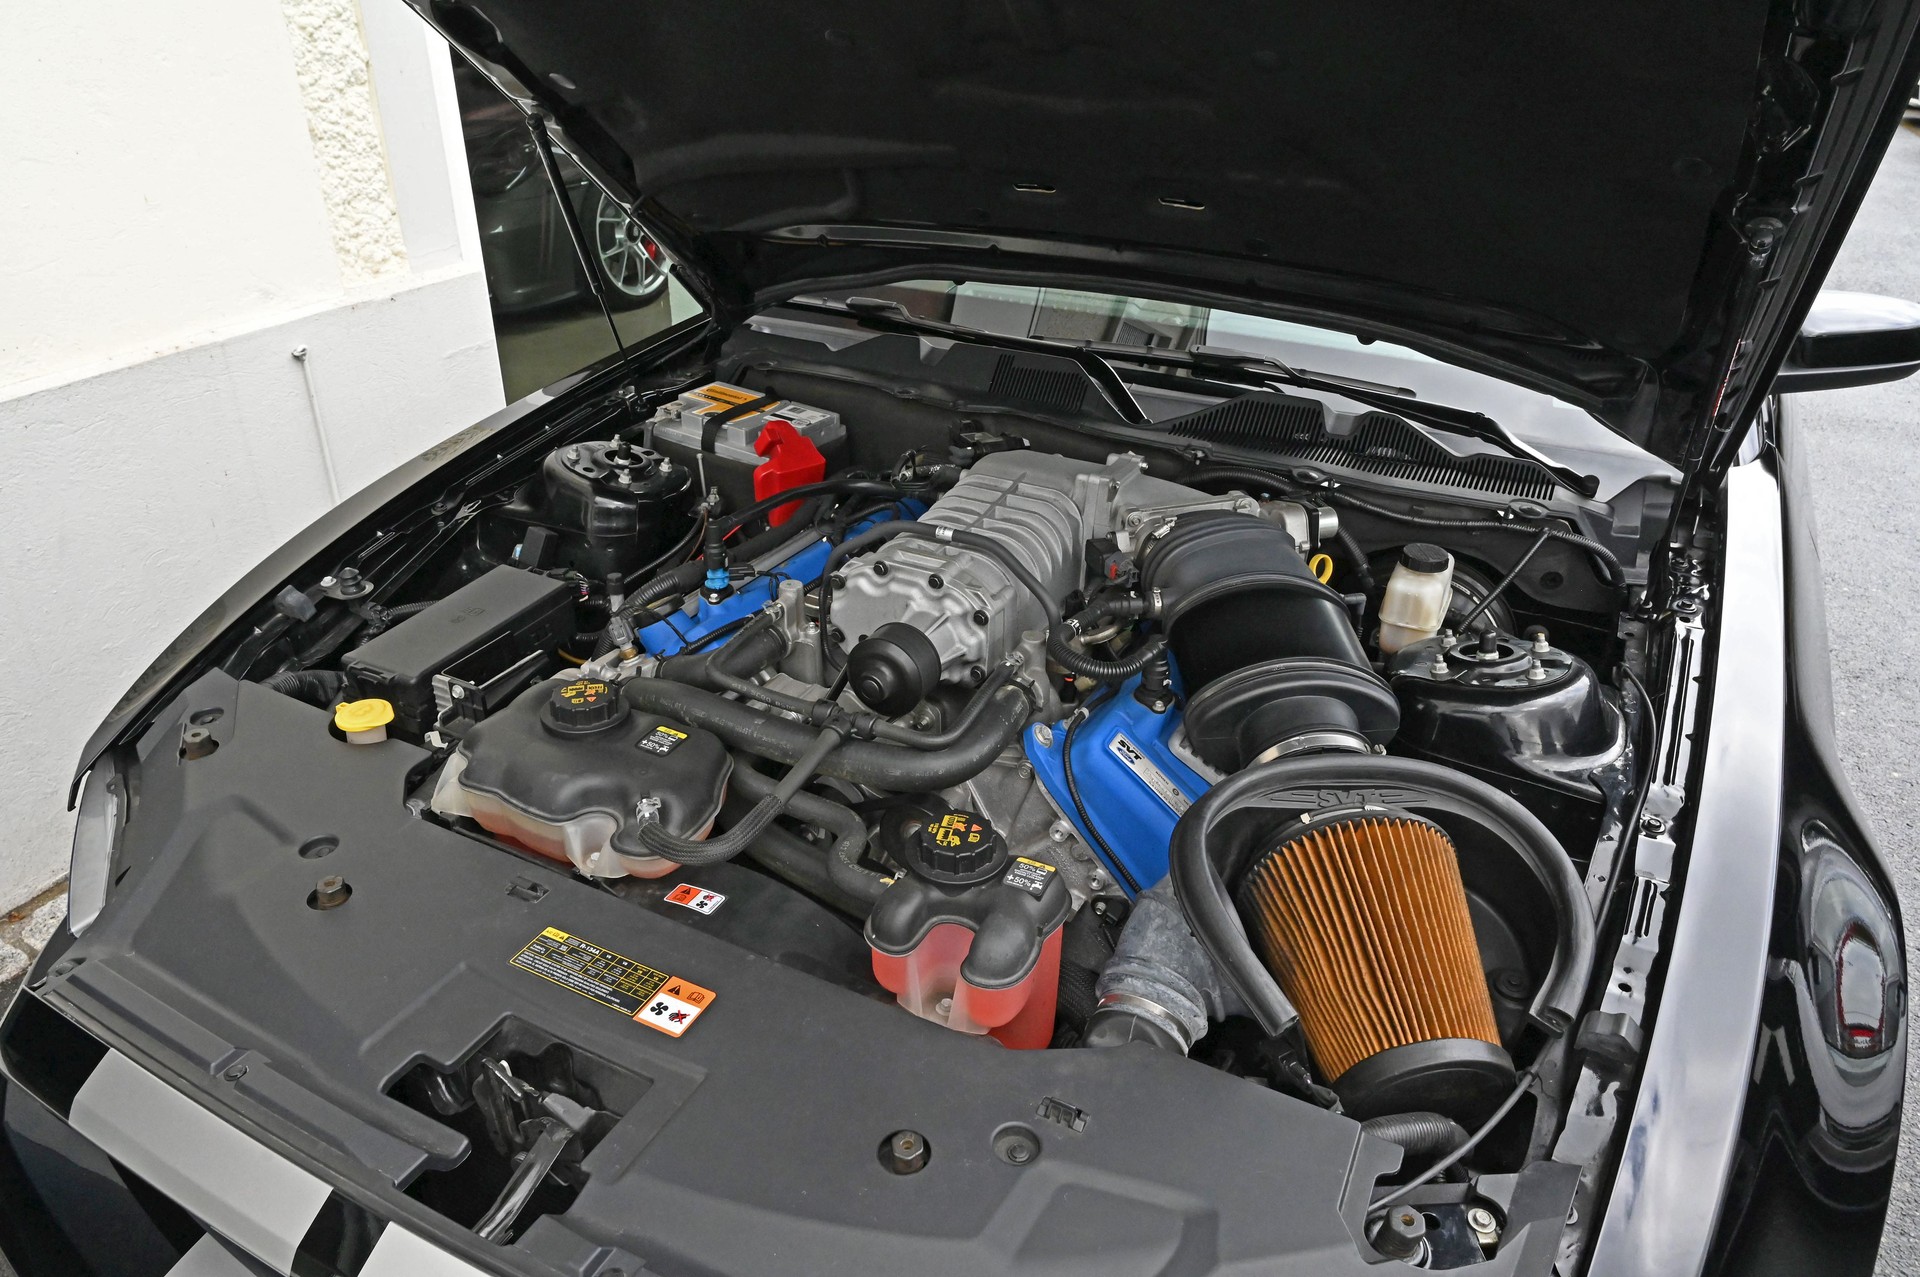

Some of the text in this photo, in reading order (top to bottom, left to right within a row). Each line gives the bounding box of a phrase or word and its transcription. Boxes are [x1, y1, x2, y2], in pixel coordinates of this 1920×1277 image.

[1118, 739, 1142, 761] SVT
[1318, 789, 1376, 808] SVT
[1018, 863, 1037, 872] 50%
[580, 943, 600, 955] R-134A
